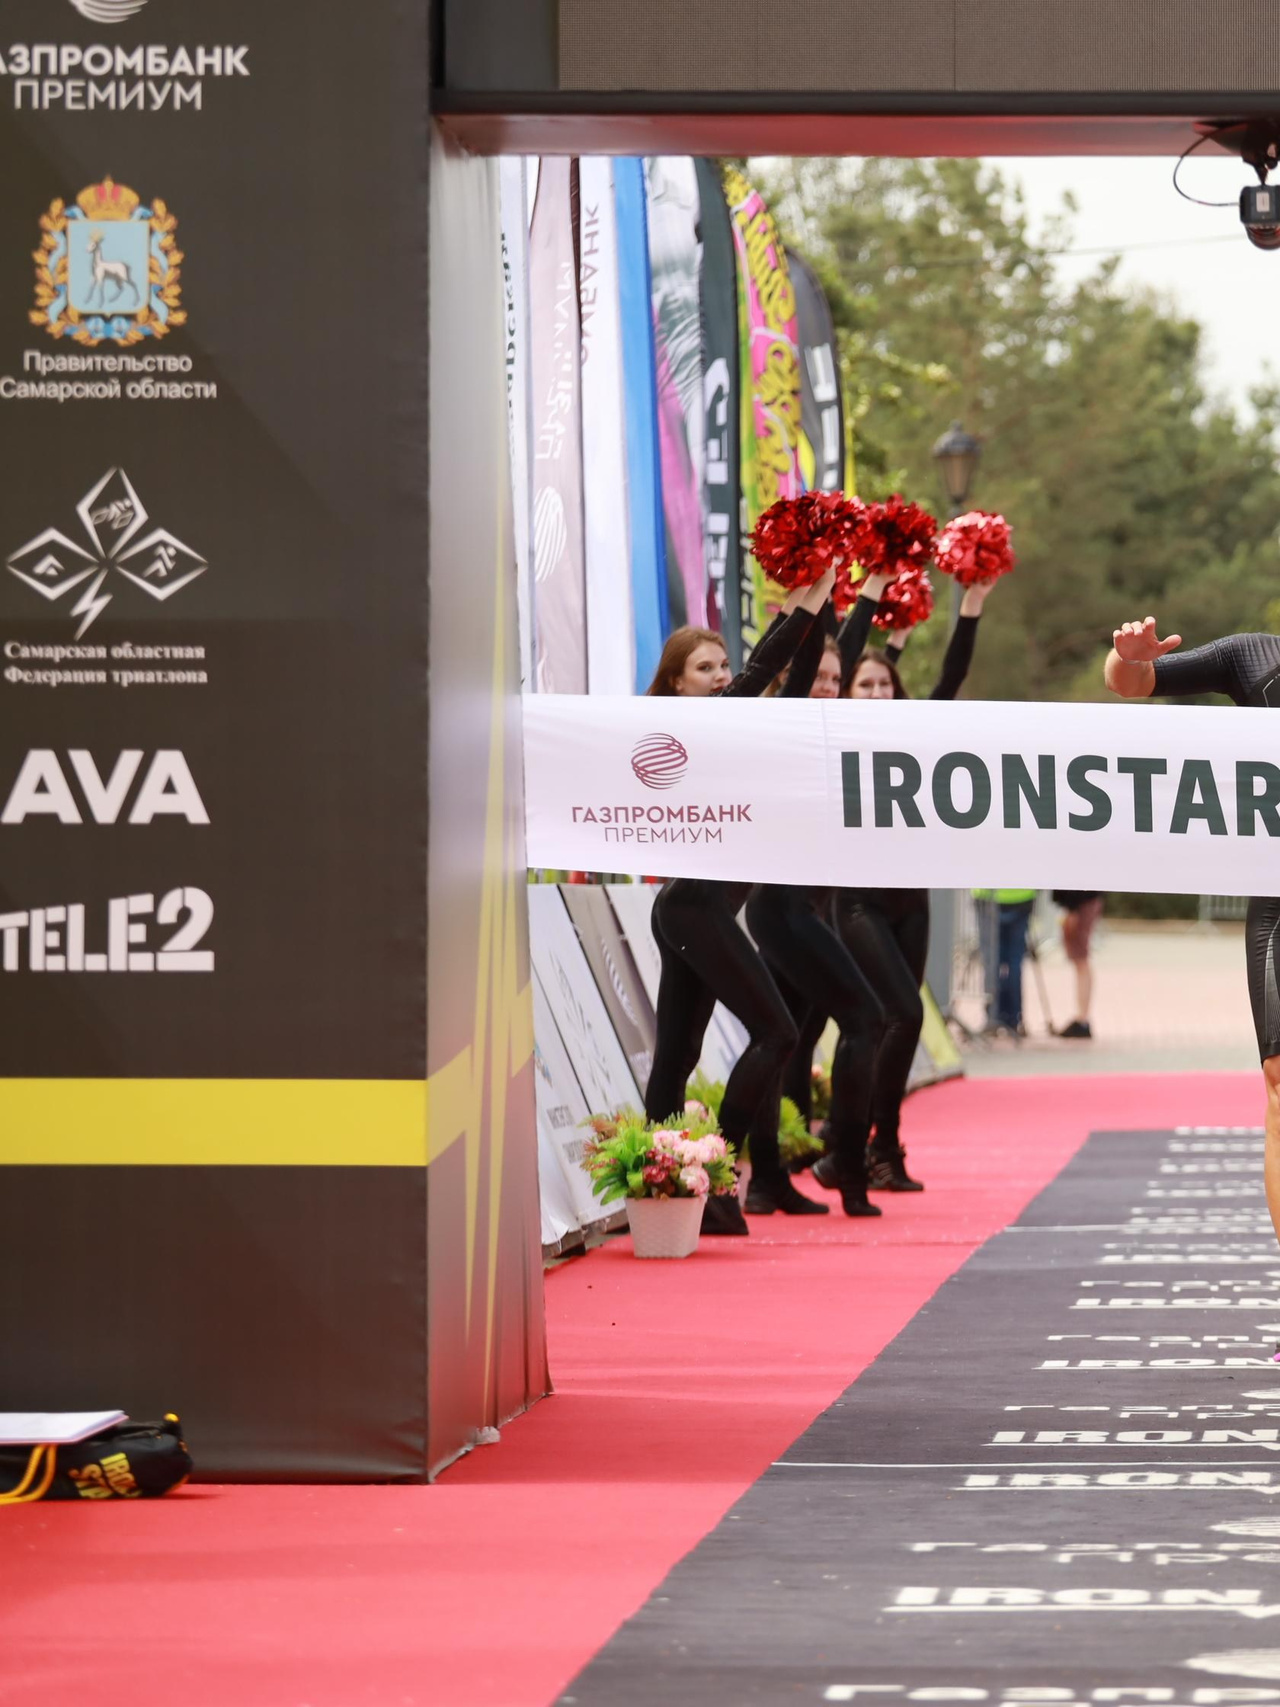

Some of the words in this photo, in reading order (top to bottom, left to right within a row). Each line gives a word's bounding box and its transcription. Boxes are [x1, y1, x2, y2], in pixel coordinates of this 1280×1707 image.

[13, 79, 203, 110] ПРЕМИУМ
[23, 350, 193, 375] Правительство
[0, 377, 120, 403] Самарской
[126, 378, 217, 399] области
[4, 641, 107, 661] Самарская
[111, 642, 206, 660] областная
[4, 666, 107, 686] Федерация
[112, 668, 208, 686] триатлона
[0, 749, 211, 825] AVA
[571, 803, 753, 826] ГАЗПРОМБАНК
[604, 826, 723, 844] ПРЕМИУМ
[0, 886, 215, 972] TELE2
[990, 1429, 1279, 1443] IRON
[963, 1472, 1273, 1486] IRON
[894, 1586, 1262, 1605] IRON
